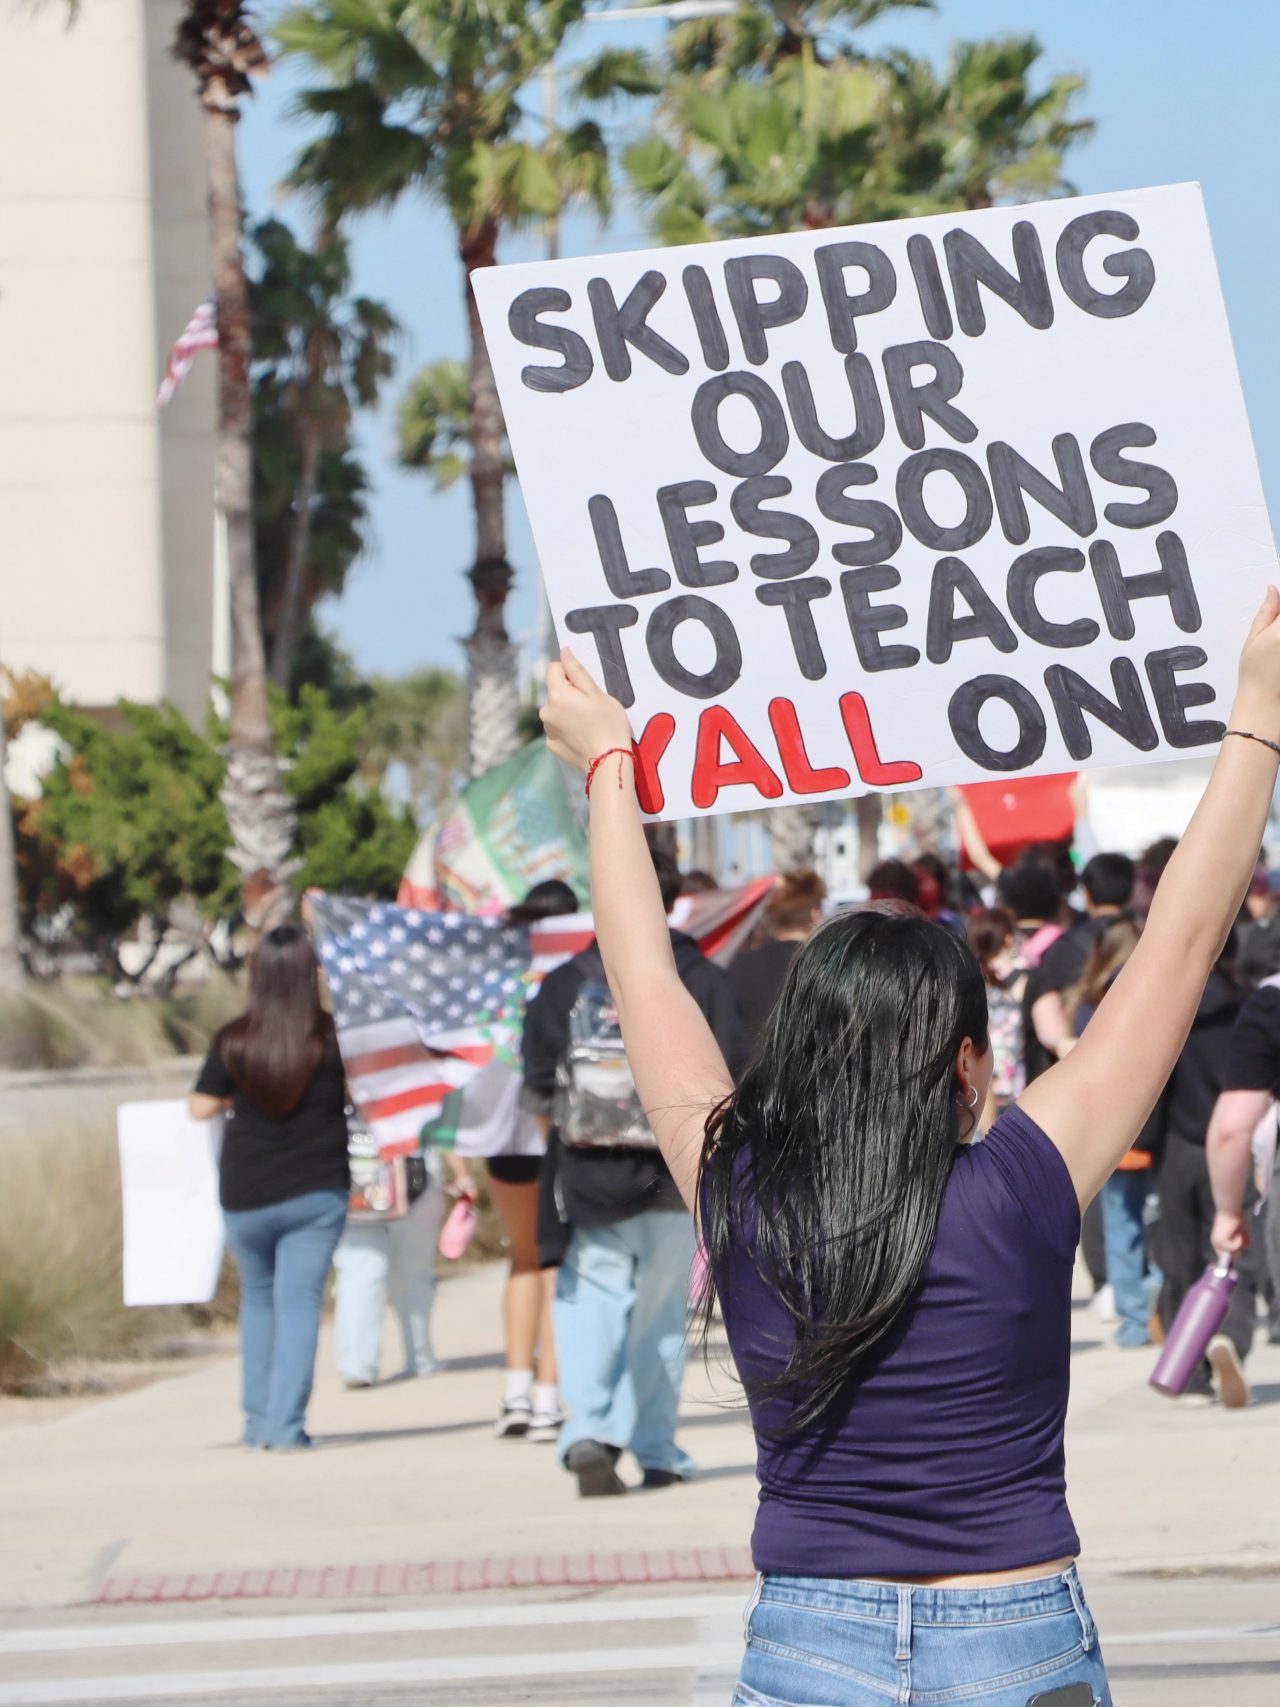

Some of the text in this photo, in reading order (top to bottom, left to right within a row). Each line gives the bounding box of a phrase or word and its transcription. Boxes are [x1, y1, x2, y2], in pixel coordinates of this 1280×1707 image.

[508, 209, 1156, 393] SKIPPING
[691, 340, 978, 477] OUR
[588, 422, 1179, 599] LESSONS
[565, 530, 1202, 709] TO TEACH
[633, 645, 1228, 814] YALL ONE
